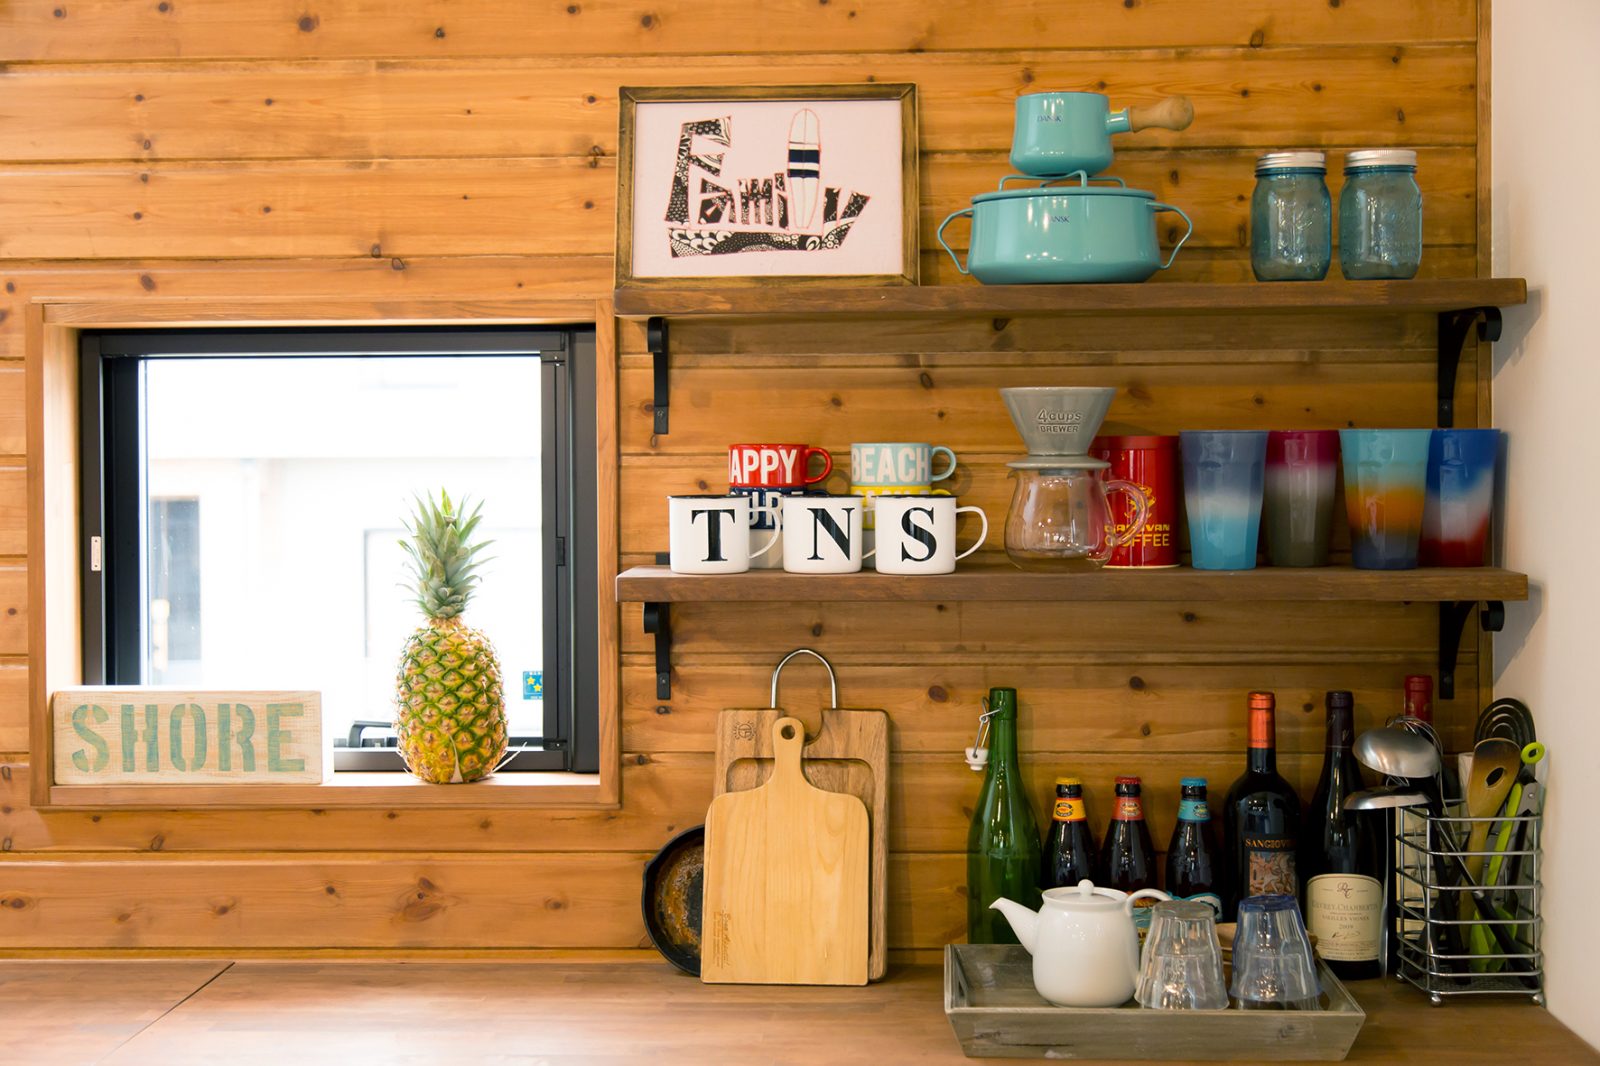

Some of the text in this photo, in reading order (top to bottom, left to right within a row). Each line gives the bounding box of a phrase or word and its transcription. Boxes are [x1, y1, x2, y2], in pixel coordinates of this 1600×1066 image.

[1040, 425, 1079, 433] BREWER
[728, 448, 798, 485] APPY
[851, 446, 929, 483] BEACH
[691, 508, 735, 562] T
[806, 507, 855, 561] N
[901, 506, 937, 563] S
[1104, 523, 1170, 533] CAVAN
[71, 703, 305, 773] SHORE
